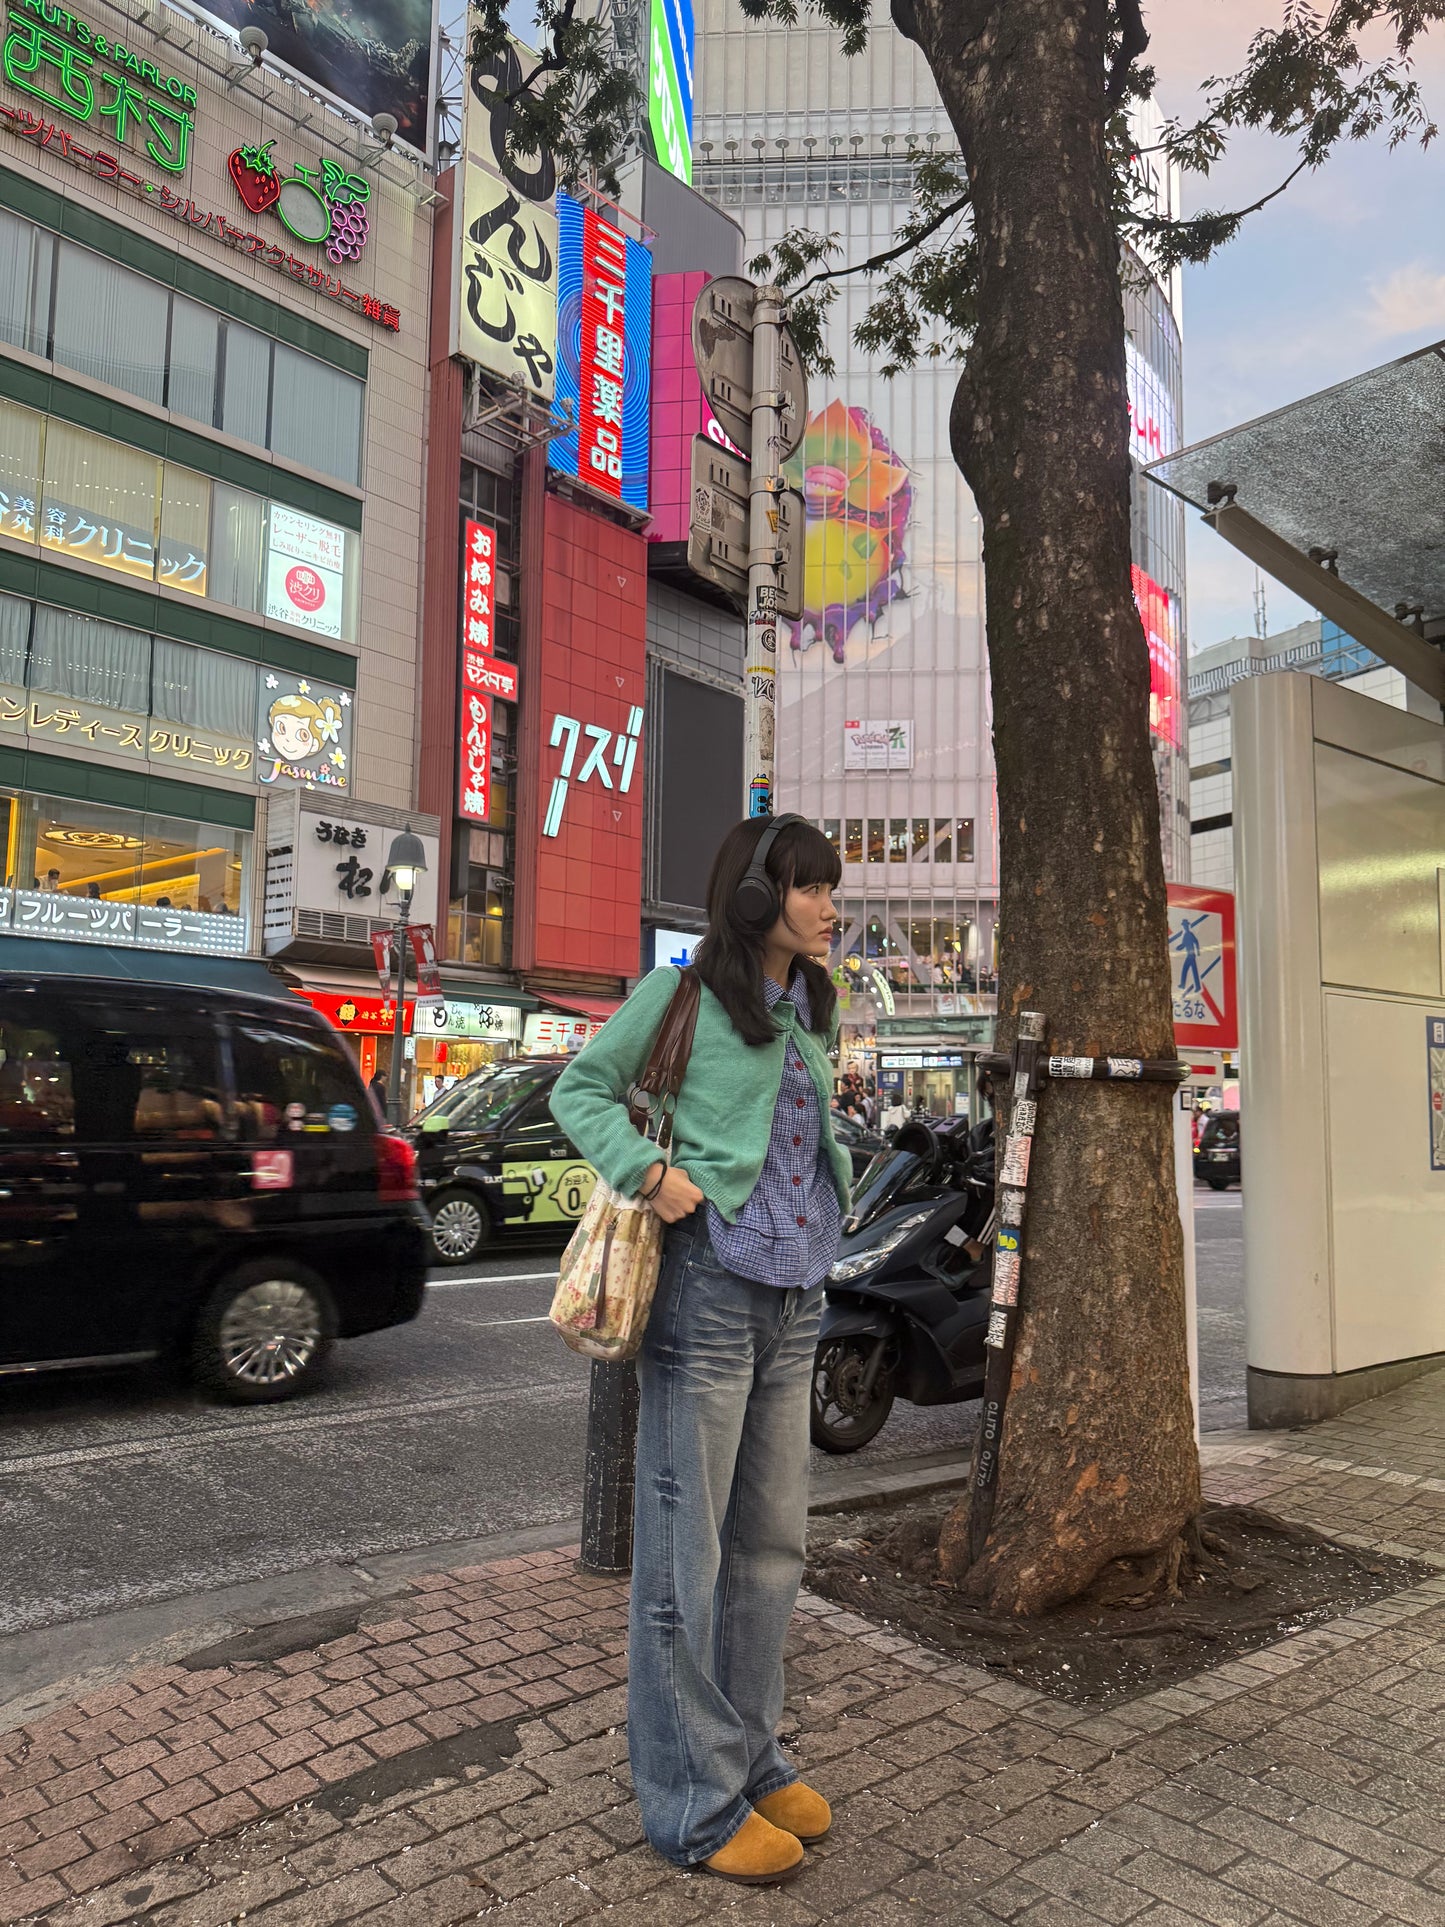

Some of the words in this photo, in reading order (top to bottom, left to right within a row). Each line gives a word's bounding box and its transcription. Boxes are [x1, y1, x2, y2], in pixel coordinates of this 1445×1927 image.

[4, 11, 196, 172] 西村
[94, 34, 110, 56] &
[113, 42, 198, 108] PARLOR
[590, 222, 626, 481] 三千里薬品
[468, 528, 492, 648] お好み焼
[259, 755, 348, 788] Jasmine
[463, 695, 487, 817] もんじゃ焼
[542, 704, 644, 838] クスリ
[315, 820, 369, 849] うなぎ
